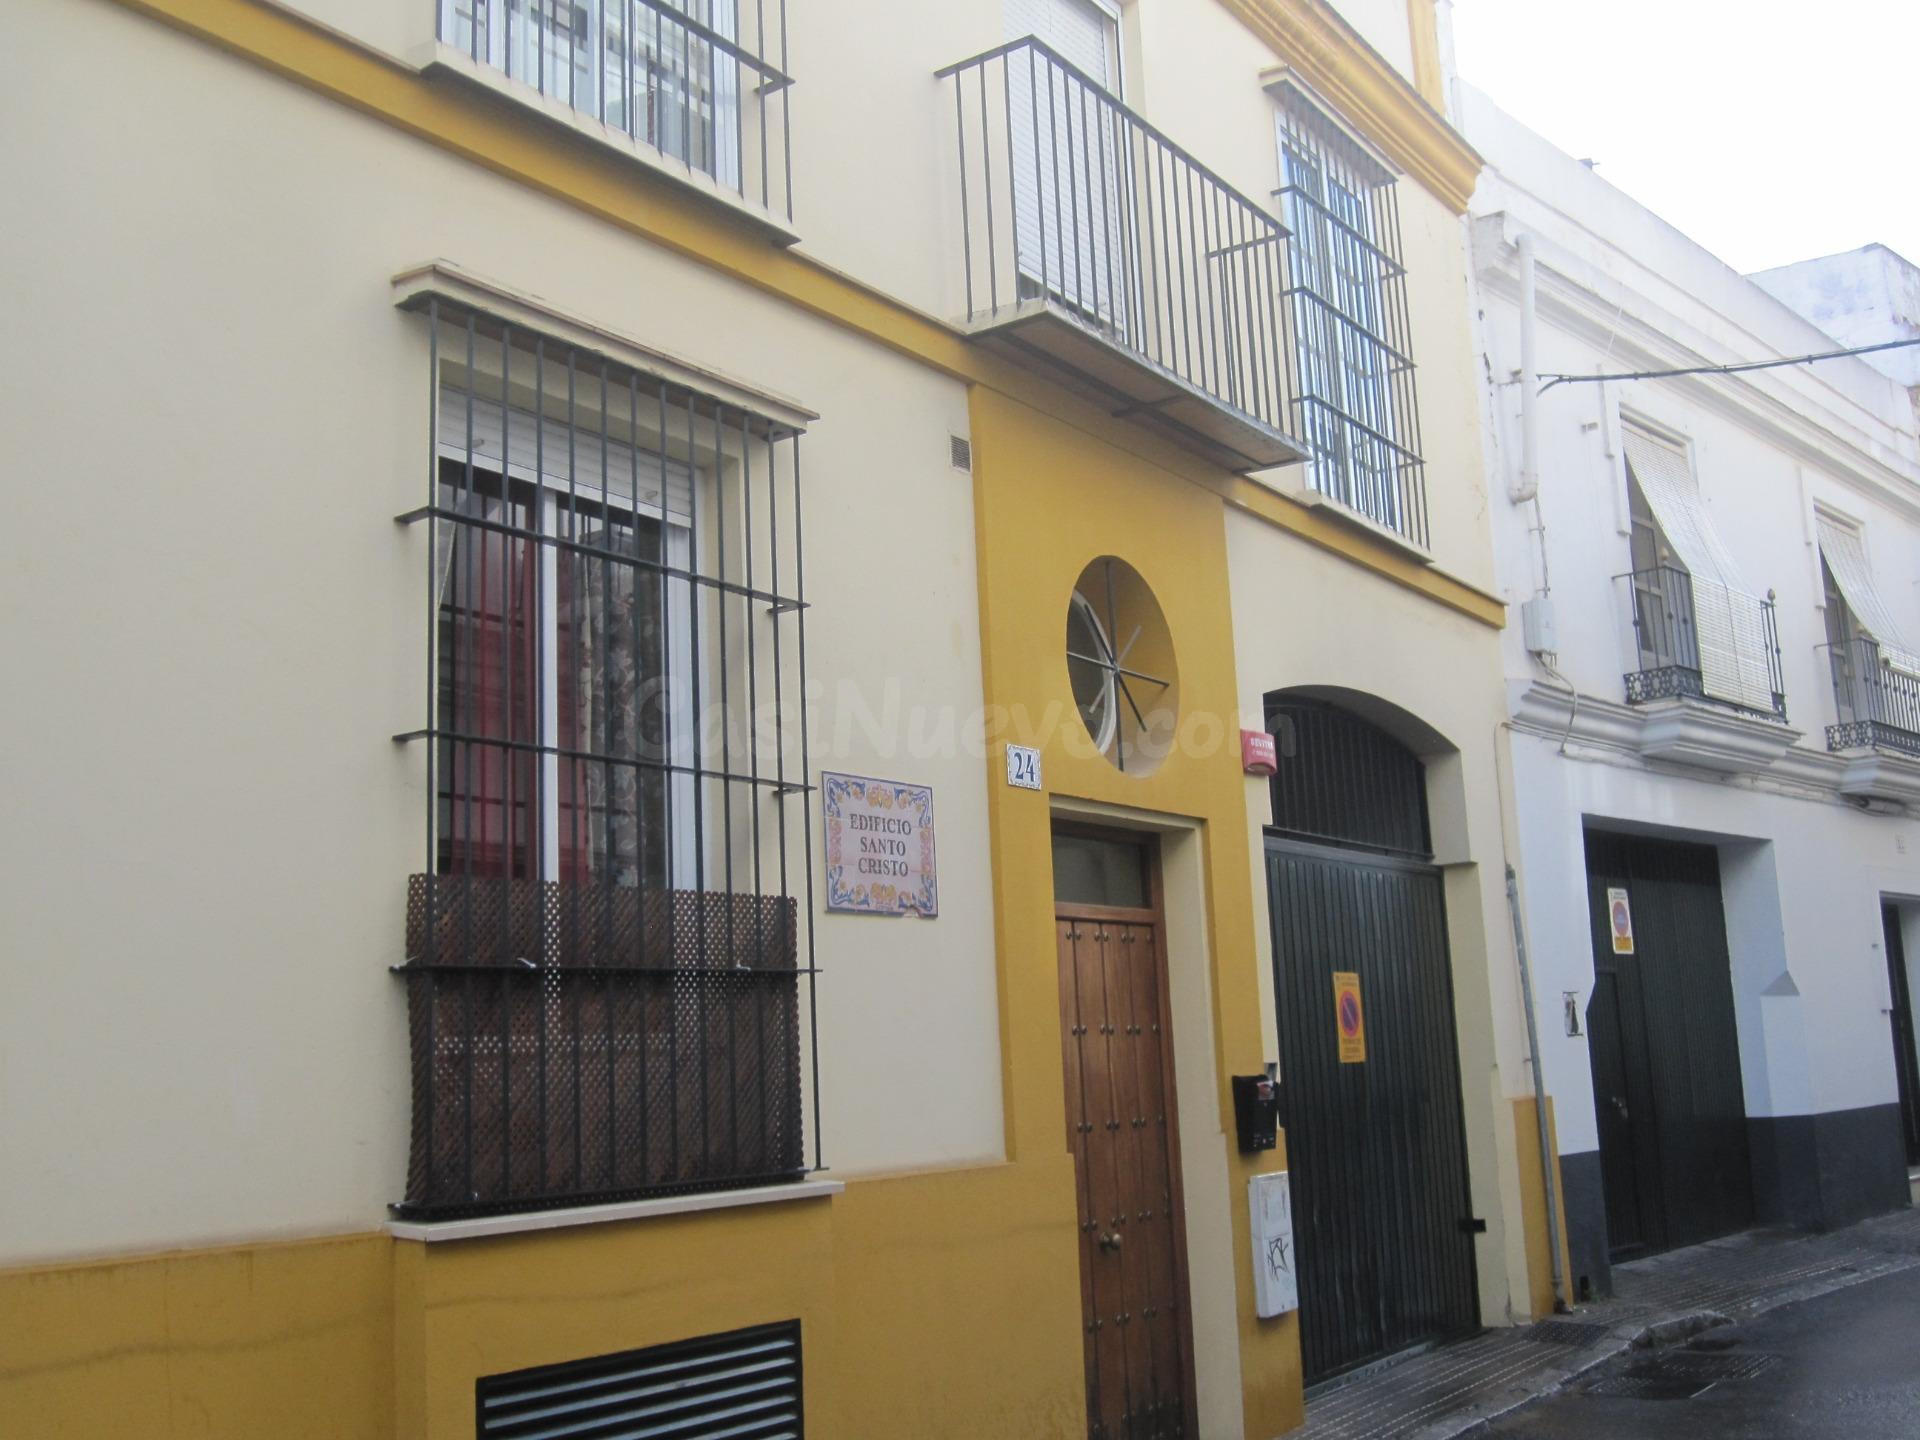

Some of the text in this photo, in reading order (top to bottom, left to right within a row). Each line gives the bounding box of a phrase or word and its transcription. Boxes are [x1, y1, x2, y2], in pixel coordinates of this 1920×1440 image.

[1013, 752, 1035, 782] 24
[850, 813, 912, 835] EDIFICIO
[860, 837, 906, 856] SANTO
[858, 858, 909, 877] CRISTO
